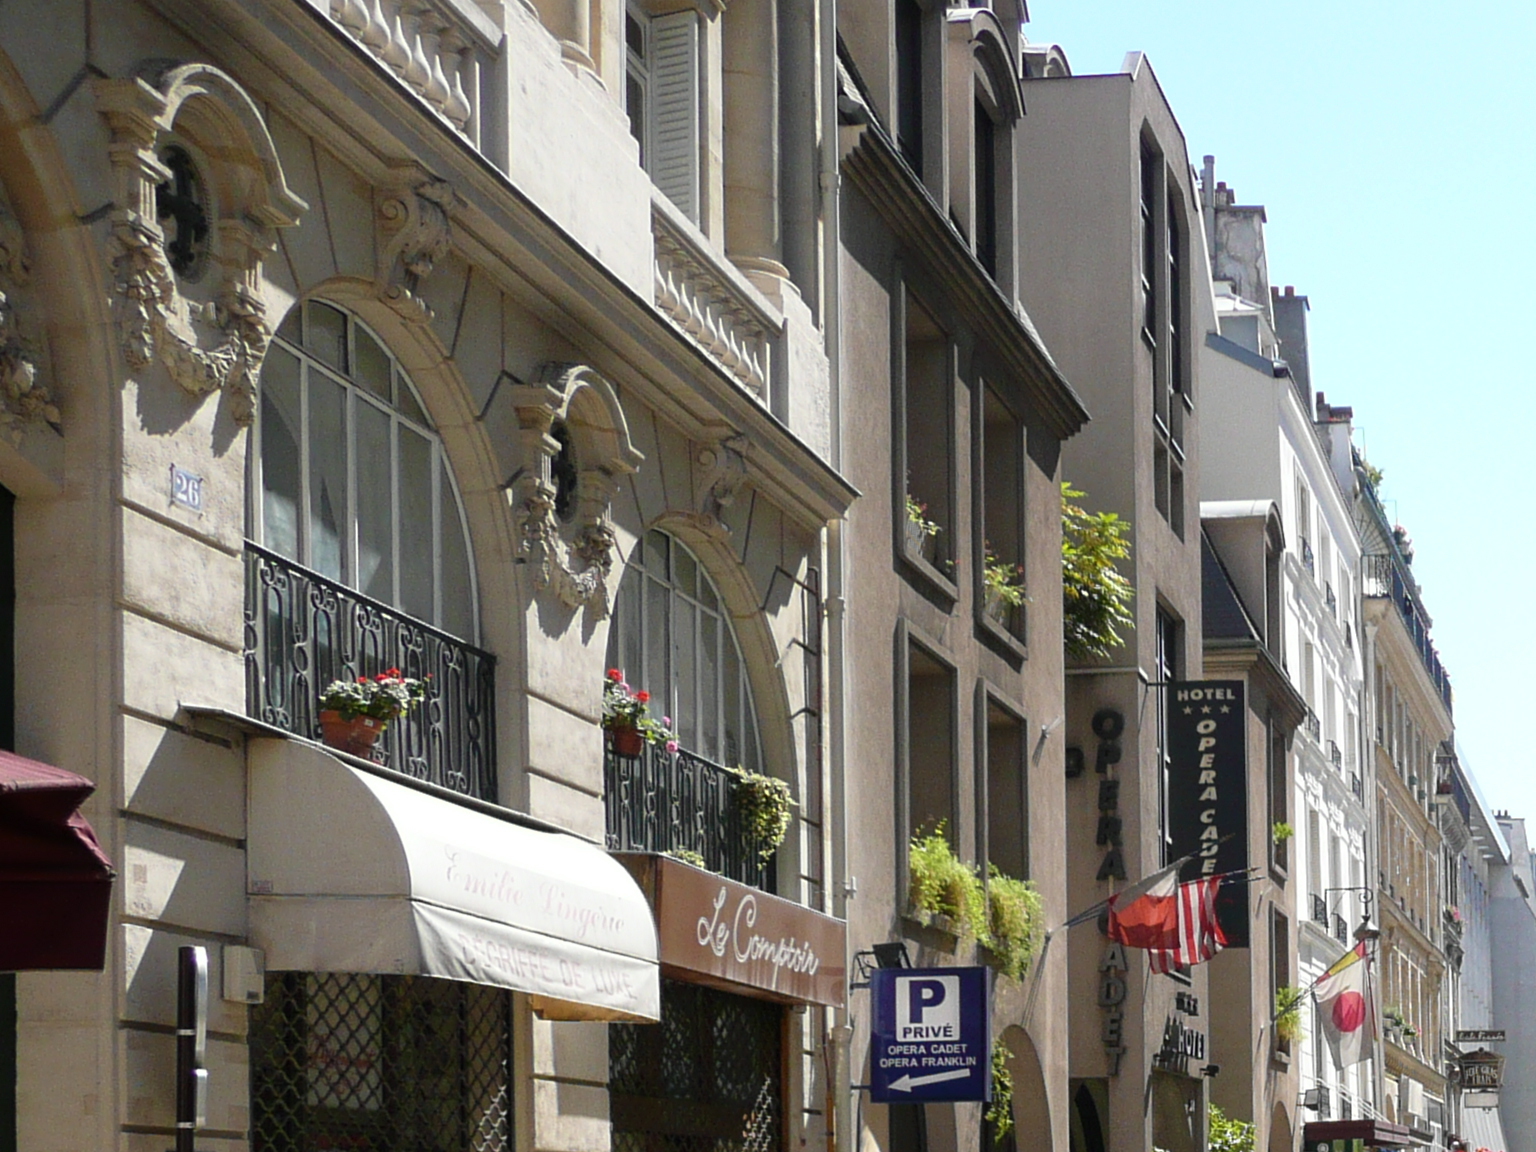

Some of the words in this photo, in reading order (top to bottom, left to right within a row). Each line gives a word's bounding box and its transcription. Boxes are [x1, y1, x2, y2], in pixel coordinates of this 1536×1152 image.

[176, 472, 199, 506] 26
[1177, 688, 1236, 702] HOTEL
[1197, 719, 1218, 801] OPERA
[1199, 808, 1219, 880] CADE
[696, 885, 730, 957] Le
[732, 893, 820, 991] Comptoir
[908, 979, 947, 1024] P
[902, 1022, 954, 1039] PRIVÉ
[879, 1057, 919, 1068] OPERA
[921, 1056, 977, 1067] FRANKLIN
[887, 1045, 927, 1056] OPERA
[930, 1043, 968, 1055] CADET
